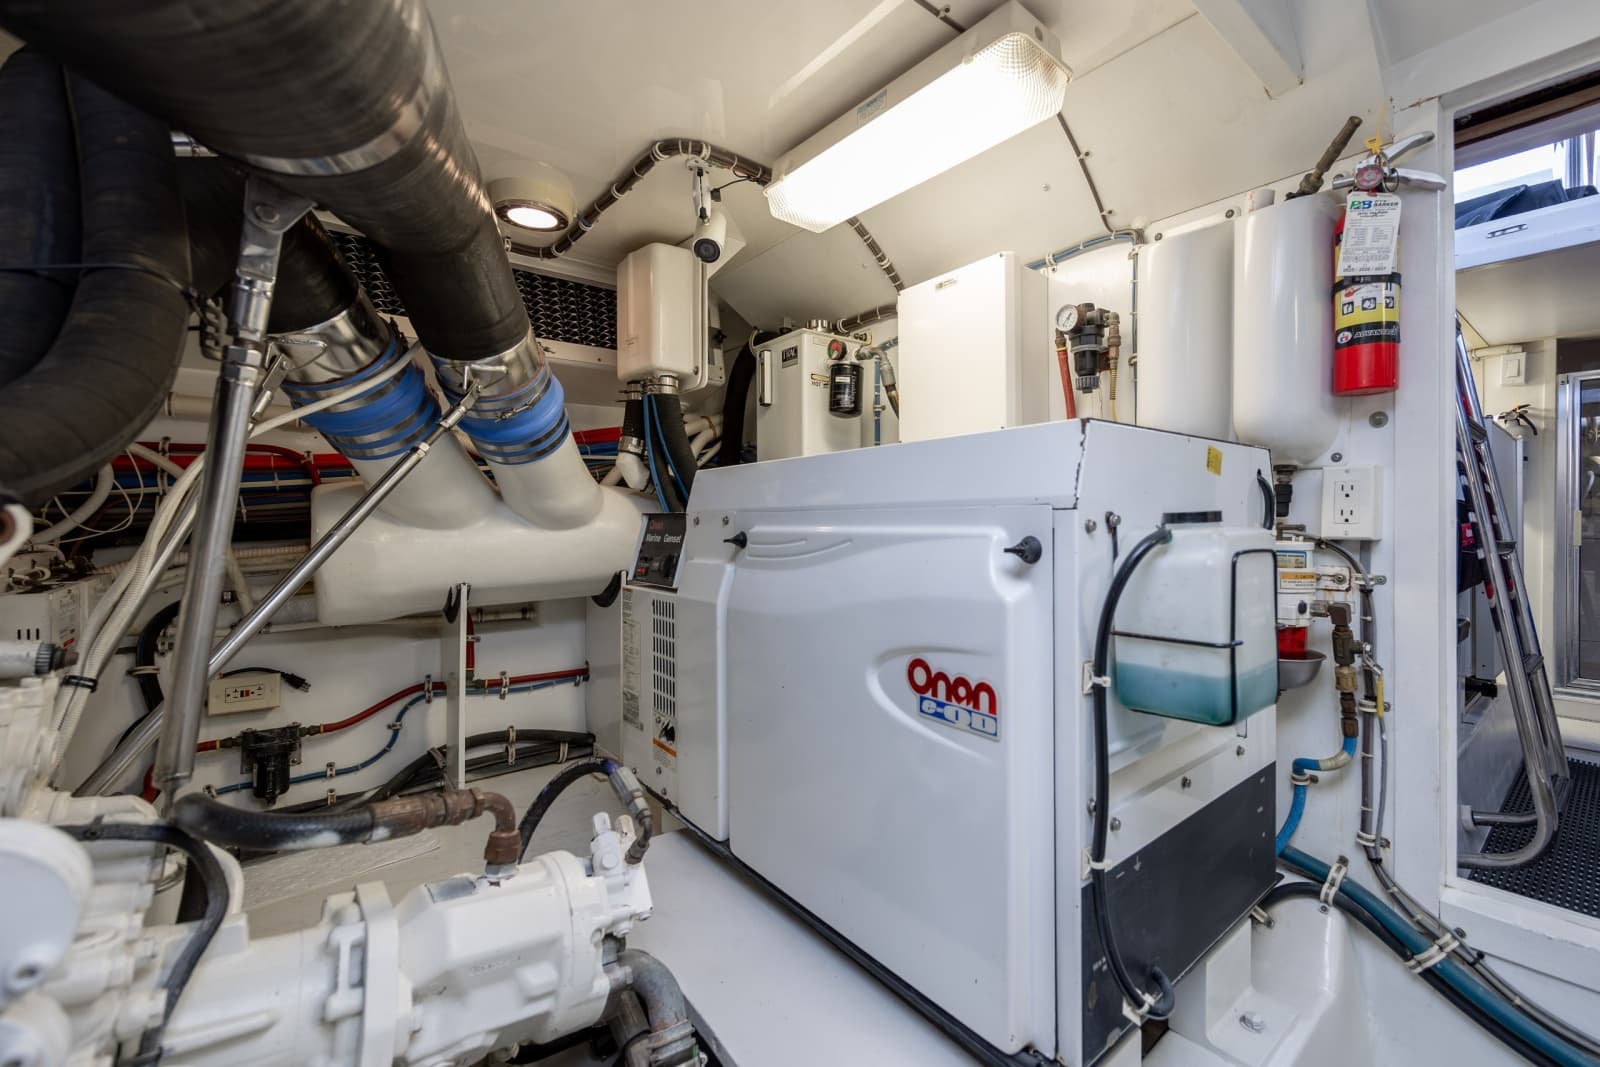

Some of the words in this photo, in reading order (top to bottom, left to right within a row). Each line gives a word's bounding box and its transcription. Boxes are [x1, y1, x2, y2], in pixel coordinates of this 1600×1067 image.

[646, 533, 662, 542] Marine
[664, 533, 682, 543] Genset
[907, 658, 997, 715] Onan
